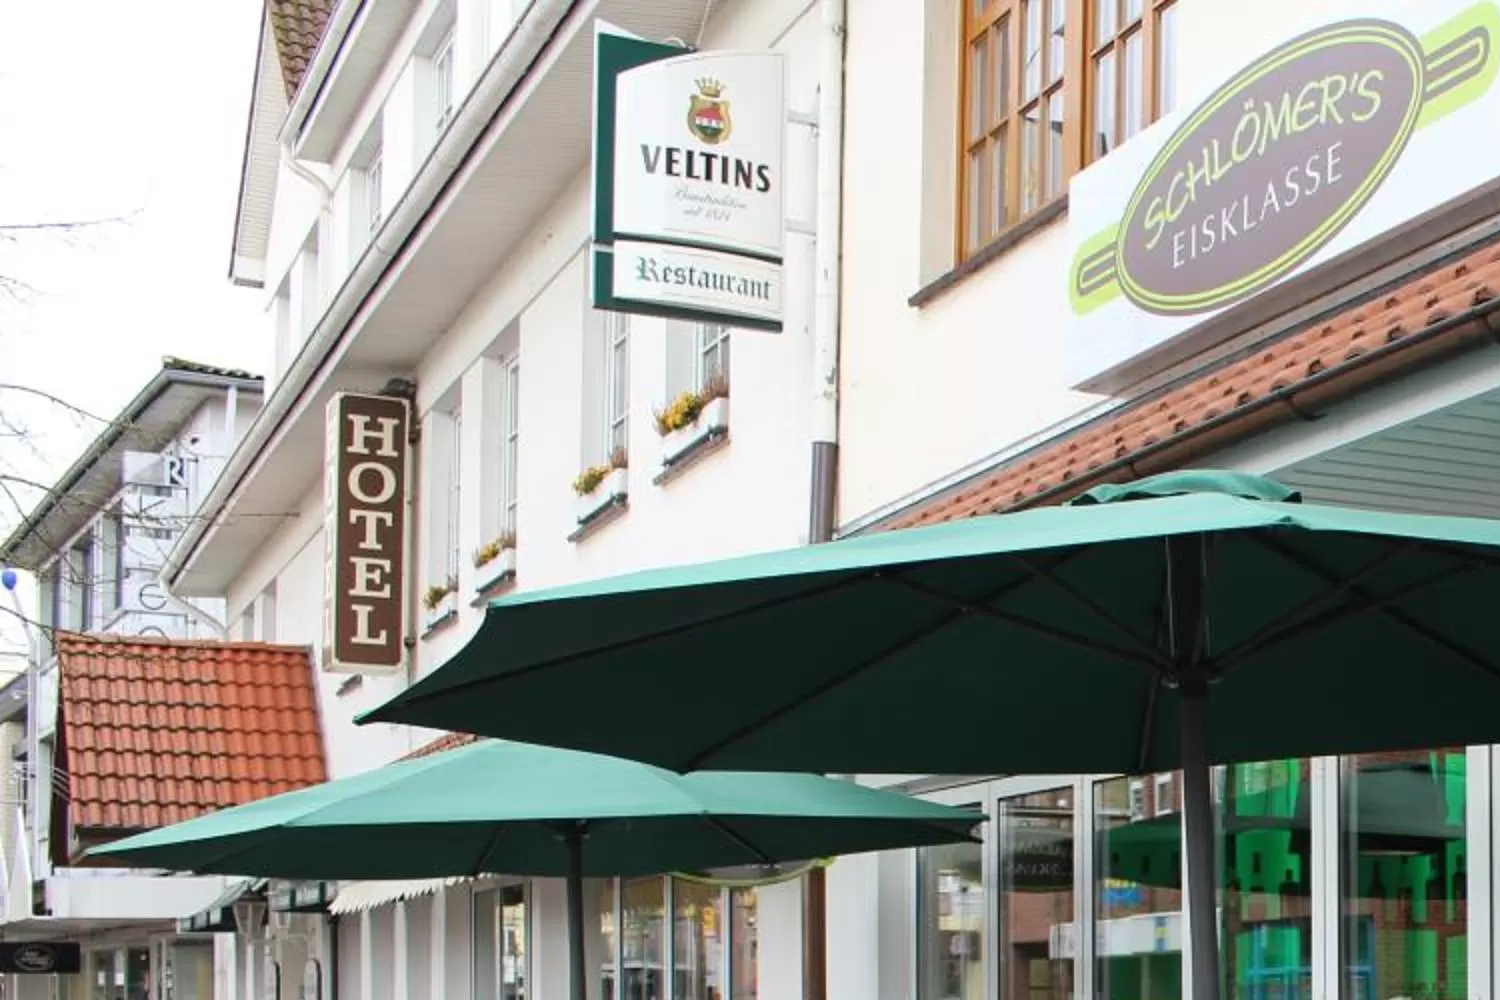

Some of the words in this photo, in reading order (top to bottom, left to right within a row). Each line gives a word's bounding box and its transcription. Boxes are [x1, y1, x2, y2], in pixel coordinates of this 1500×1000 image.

[640, 143, 771, 193] VELTINS
[1143, 69, 1385, 250] SCHLÖMER'S
[1172, 140, 1344, 269] EISKLASSE
[635, 256, 772, 301] Restaurant
[346, 413, 401, 646] HOTEL
